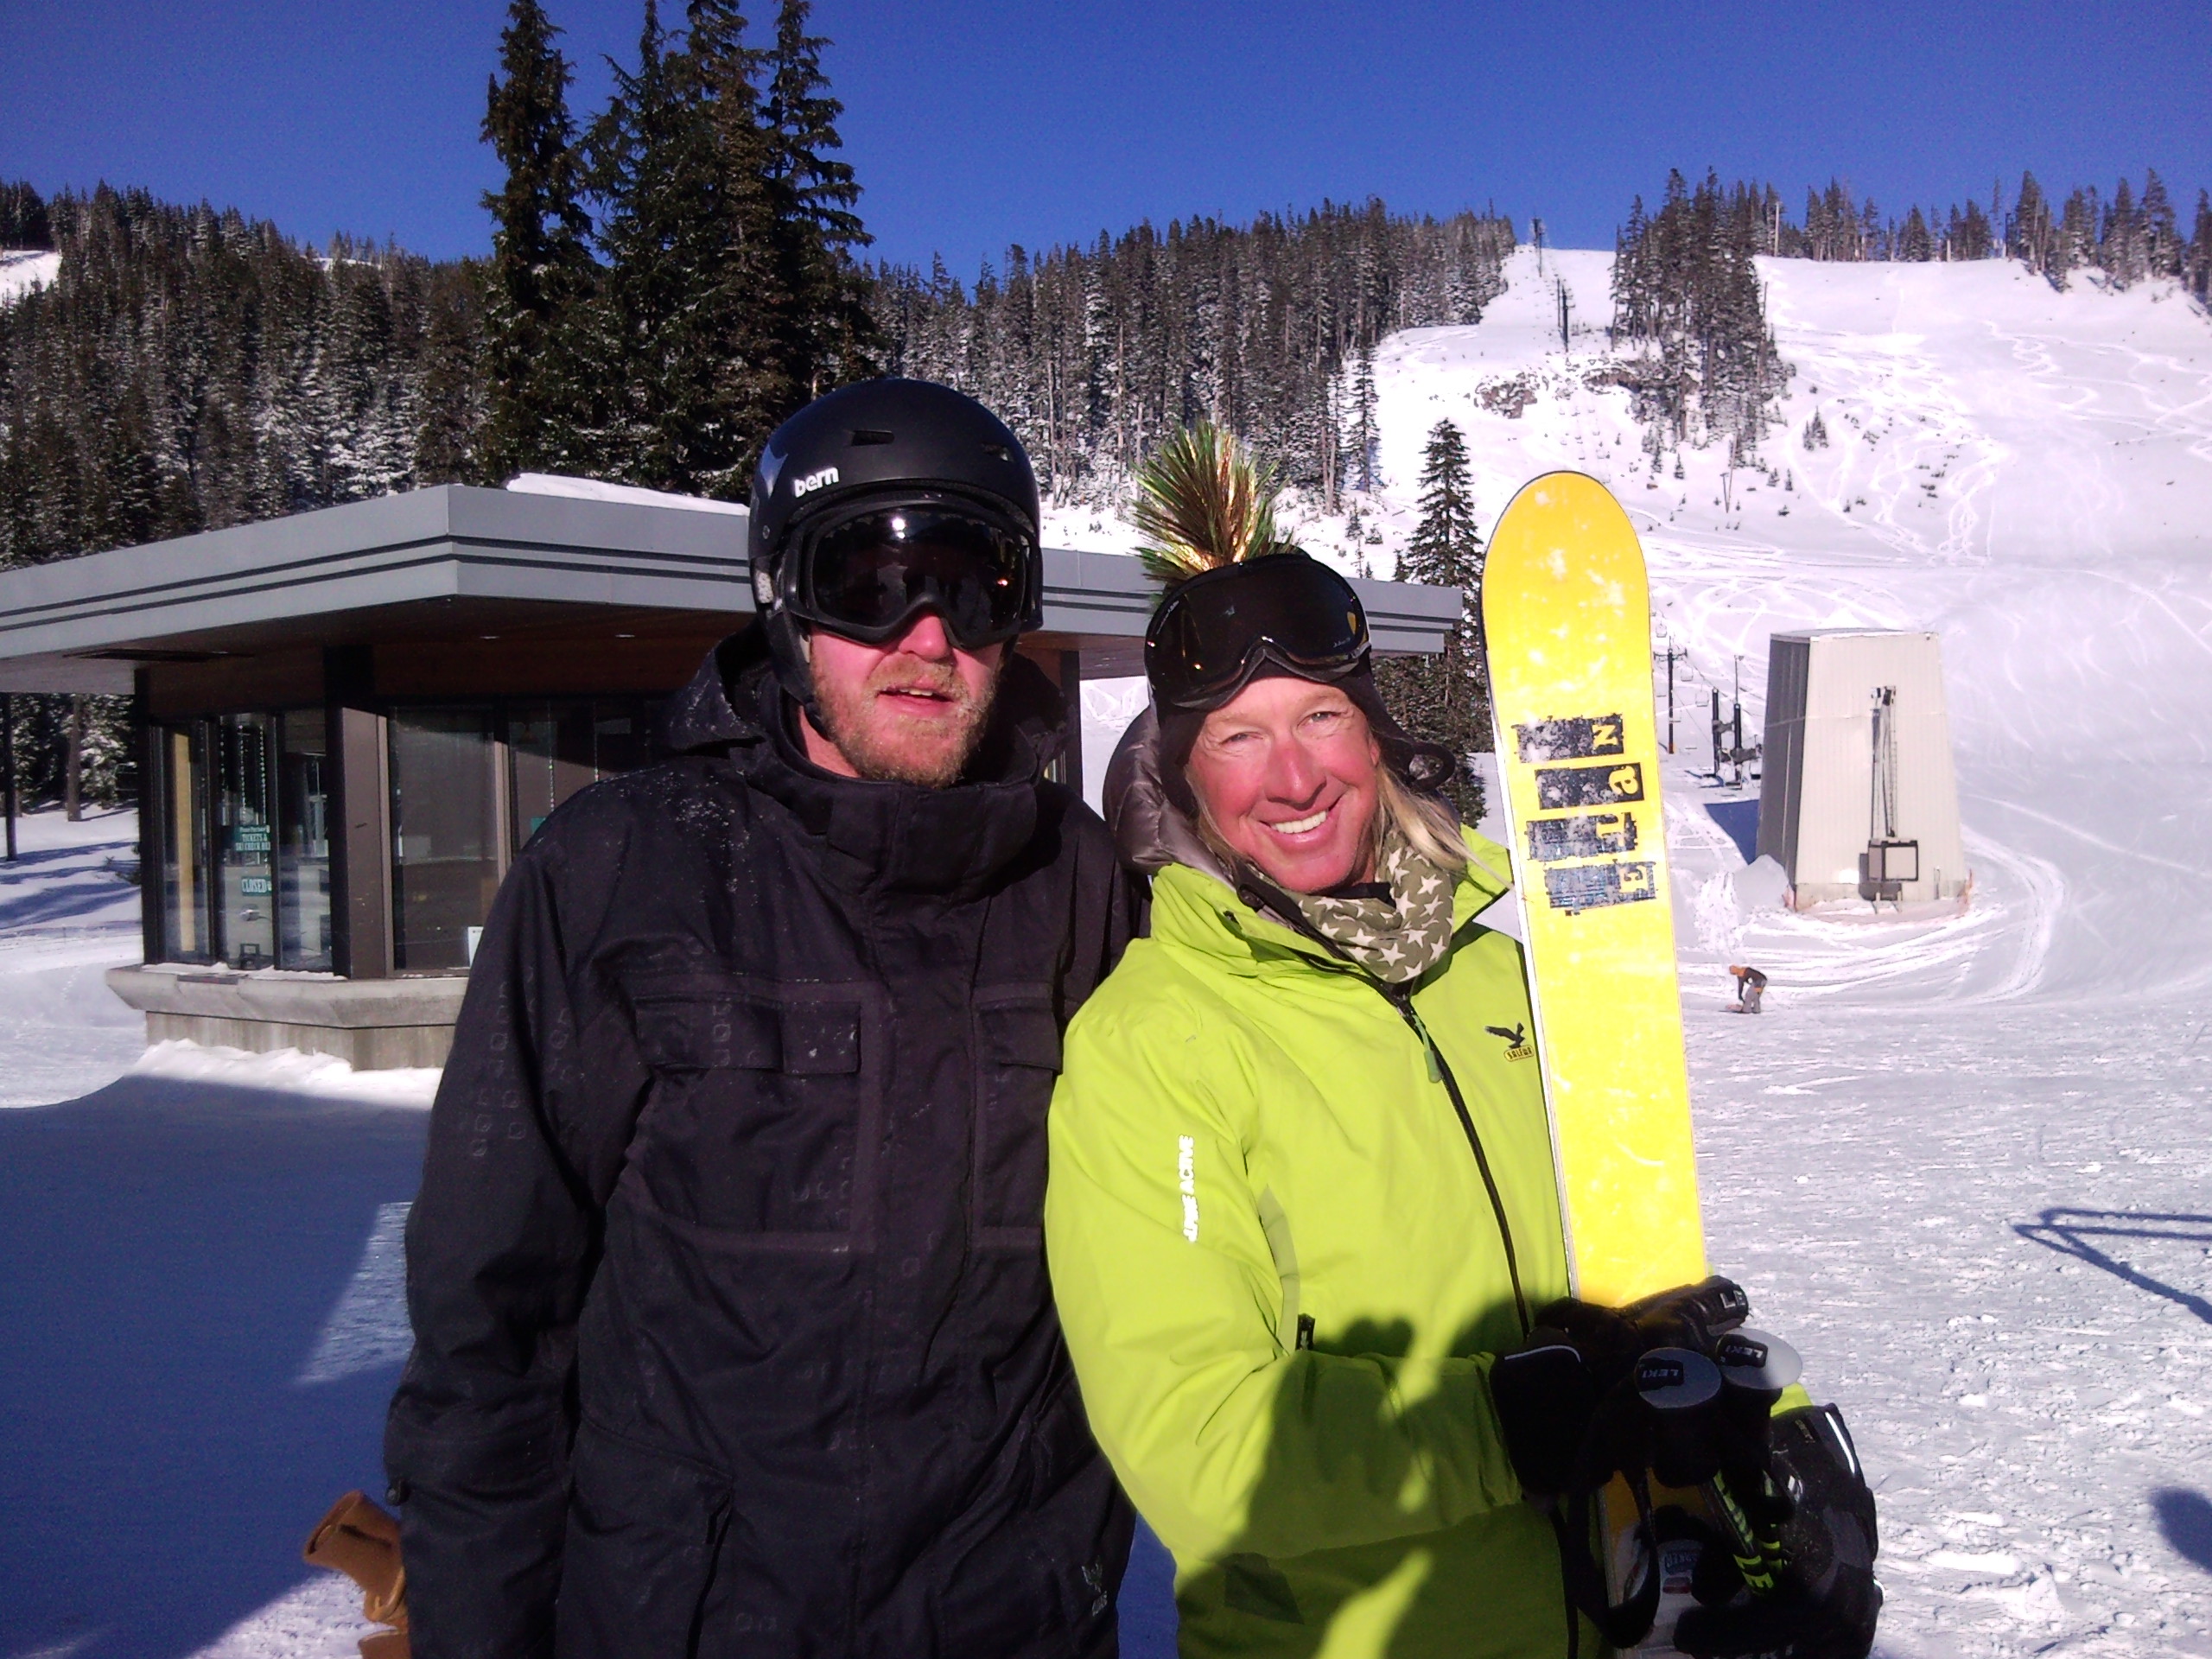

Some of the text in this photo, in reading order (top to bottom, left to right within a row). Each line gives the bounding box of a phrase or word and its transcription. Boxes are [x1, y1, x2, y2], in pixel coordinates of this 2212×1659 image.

[793, 467, 840, 499] bern
[241, 878, 267, 893] CLOSED
[1178, 1134, 1195, 1195] ACTIVE
[1725, 1344, 1764, 1359] LEKI
[1642, 1369, 1679, 1379] LEKI
